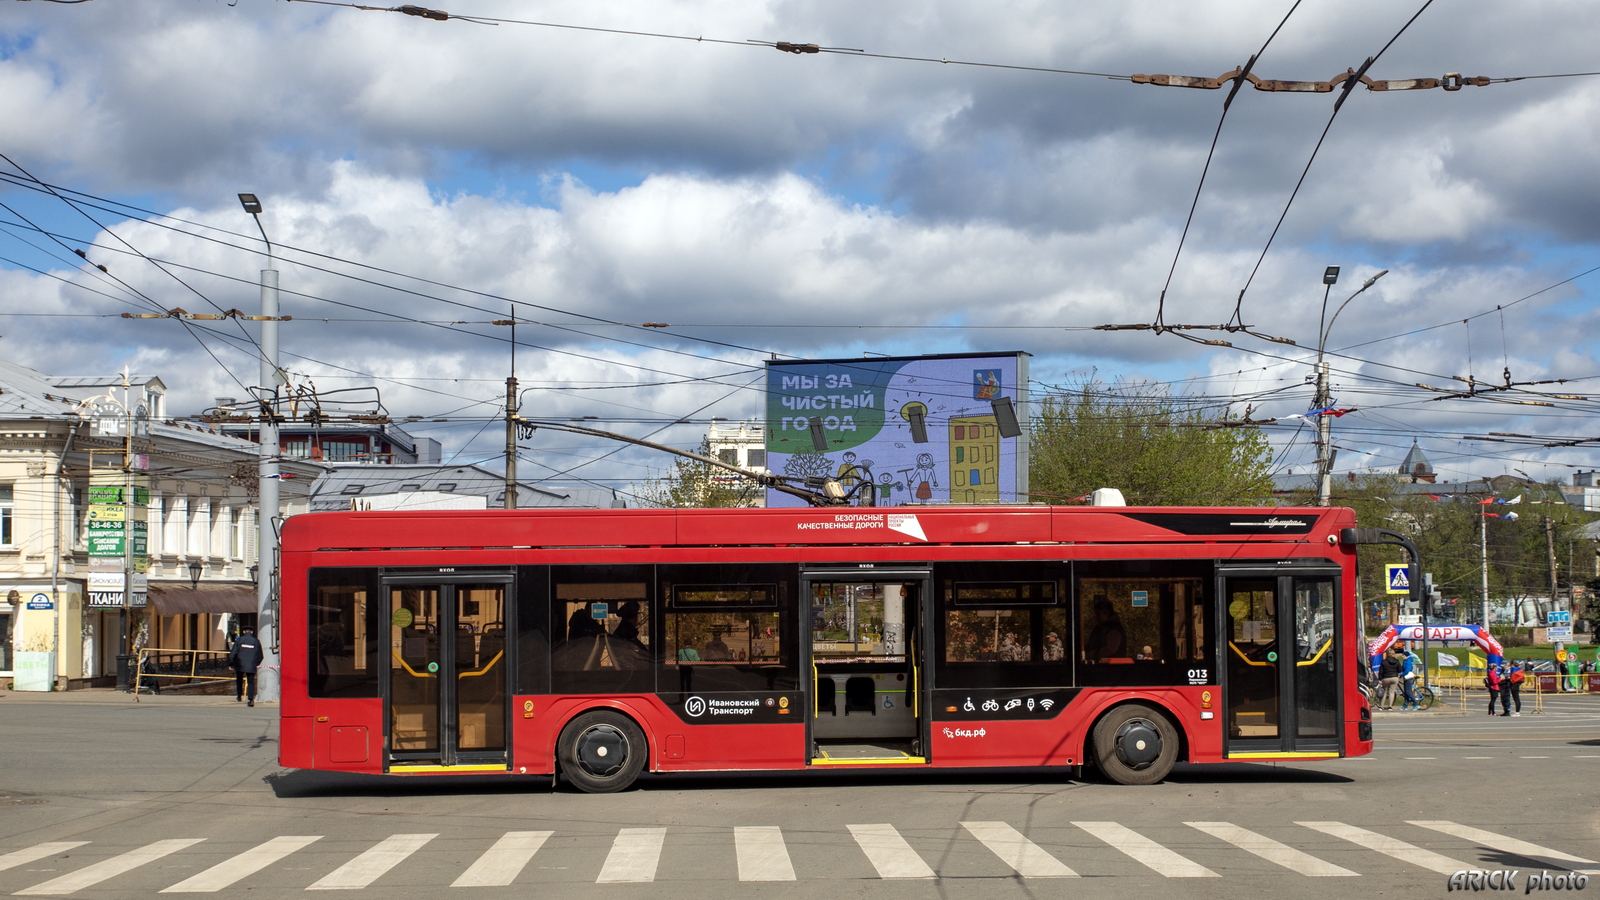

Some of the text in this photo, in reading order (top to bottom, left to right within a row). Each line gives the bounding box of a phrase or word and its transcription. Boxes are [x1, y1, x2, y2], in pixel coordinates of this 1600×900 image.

[782, 374, 853, 390] МЫ ЗА
[782, 390, 875, 411] ЧИСТЫЙ
[782, 415, 857, 432] ГООД
[834, 514, 884, 522] БЕЗОПАСНЫЕ
[91, 521, 123, 529] 36-46-36
[797, 521, 884, 530] КАЧЕСТВЕННЫЕ ДОРОГИ
[96, 544, 117, 552] ДОЛГОВ
[88, 592, 124, 605] ТКАНИ
[15, 661, 48, 669] ЦВЕТЫ
[1187, 669, 1208, 679] 013
[708, 699, 760, 707] Ивановский
[709, 707, 754, 715] Транспорт
[955, 727, 987, 738] бкд.рф
